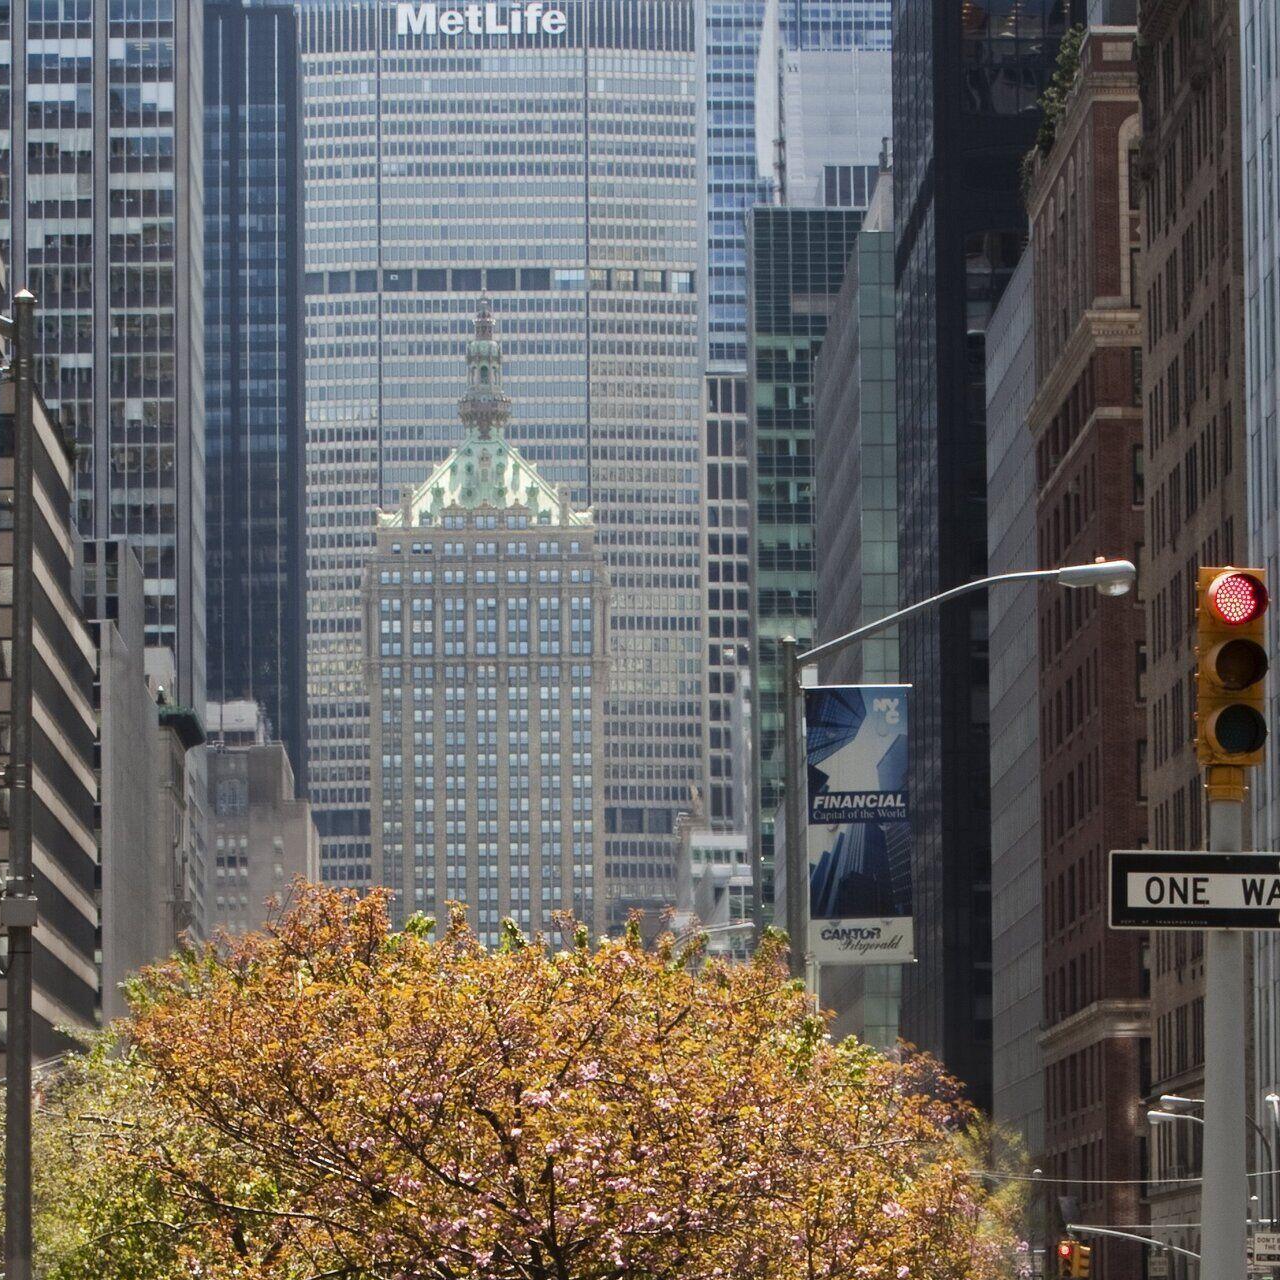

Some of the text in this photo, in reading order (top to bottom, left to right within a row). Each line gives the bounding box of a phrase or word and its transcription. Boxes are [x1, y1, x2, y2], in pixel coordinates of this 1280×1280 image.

[397, 2, 567, 35] MetLife
[813, 793, 906, 809] FINANCIAL
[813, 808, 906, 821] Capital of the World
[1145, 876, 1210, 905] ONE
[821, 927, 882, 941] CANTOR
